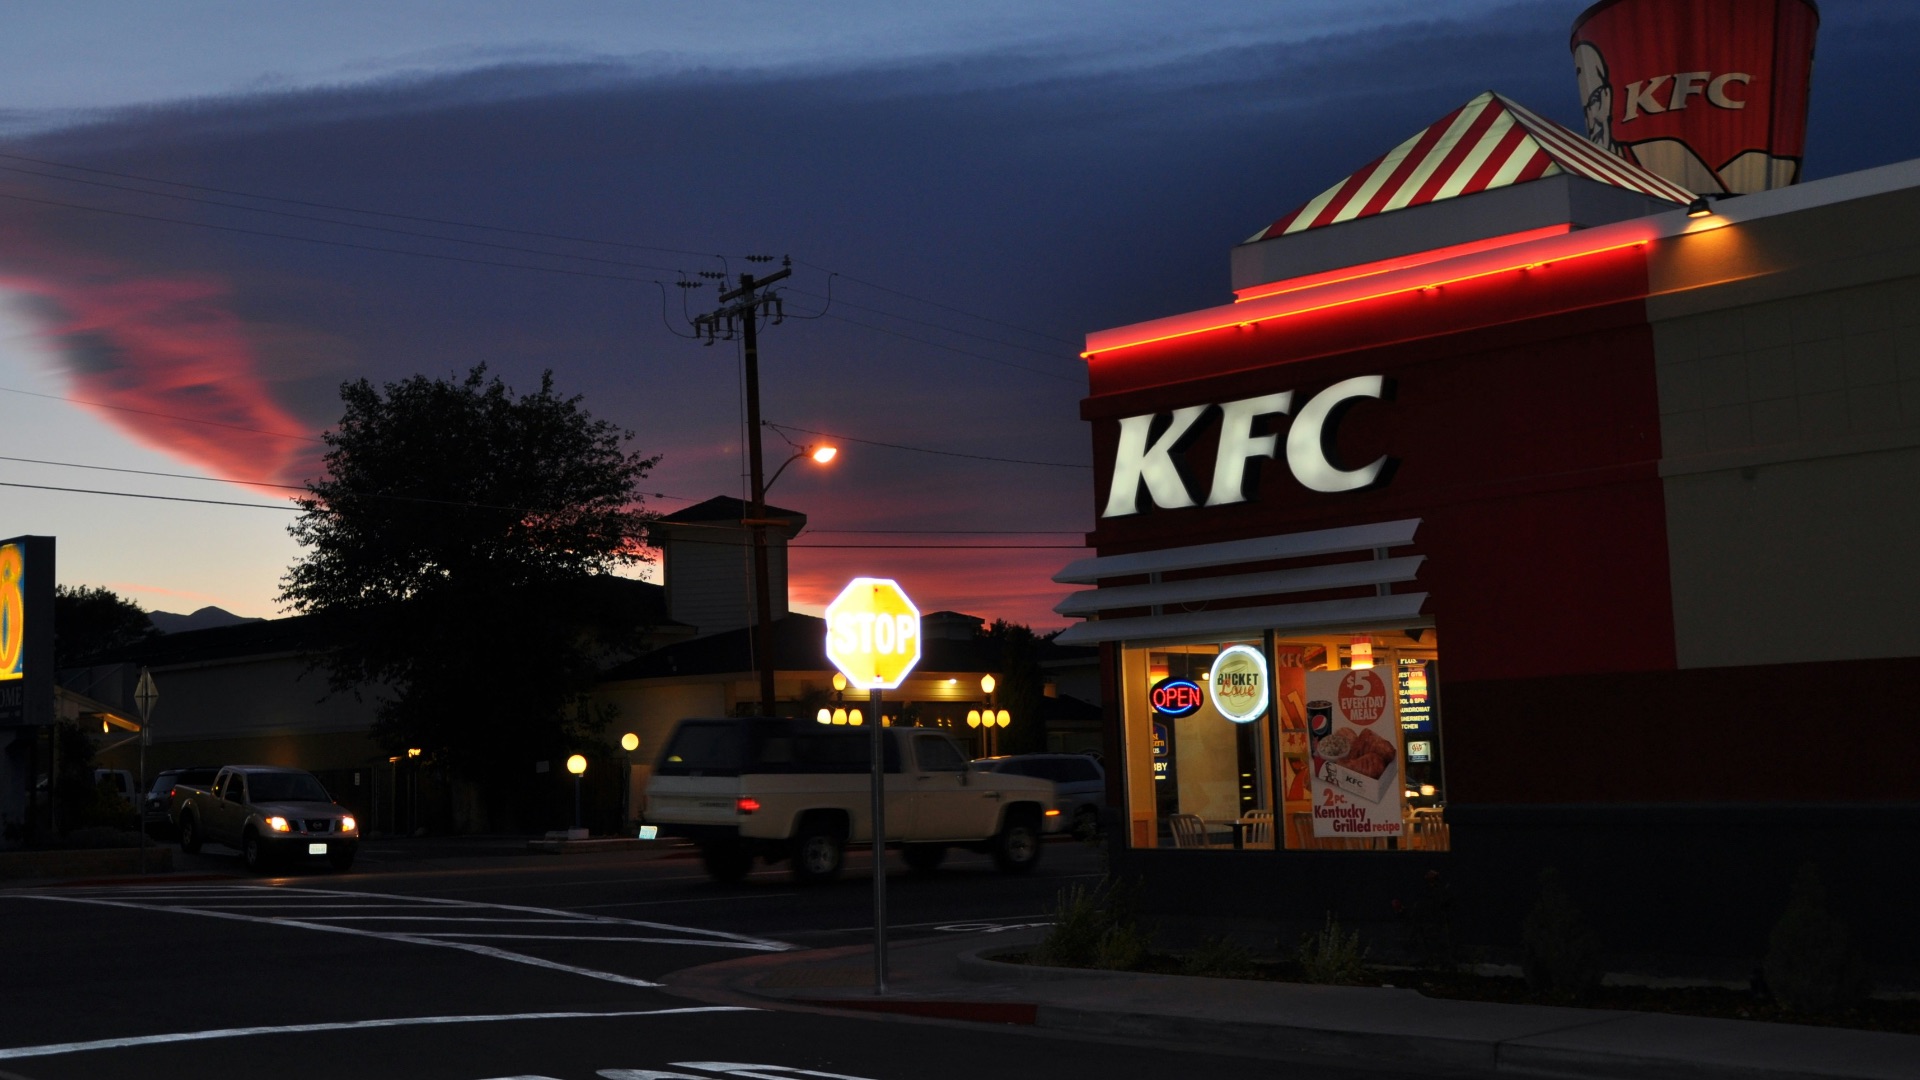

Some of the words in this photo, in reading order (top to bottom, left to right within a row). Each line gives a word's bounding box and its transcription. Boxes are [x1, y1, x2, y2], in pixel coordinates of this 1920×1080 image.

[1622, 71, 1751, 123] KFC
[1101, 374, 1389, 518] KFC
[834, 612, 915, 655] STOP
[1217, 673, 1259, 687] BUCKET
[1219, 679, 1256, 698] Love
[1346, 670, 1371, 697] $5
[1153, 687, 1201, 707] OPEN
[1341, 695, 1385, 710] EVERYDAY
[1350, 708, 1378, 721] MEALS
[1345, 775, 1364, 788] KFC
[1323, 788, 1334, 807] 2
[1314, 804, 1366, 822] Kentucky
[1333, 818, 1371, 833] Grilled
[1372, 820, 1401, 834] recipe
